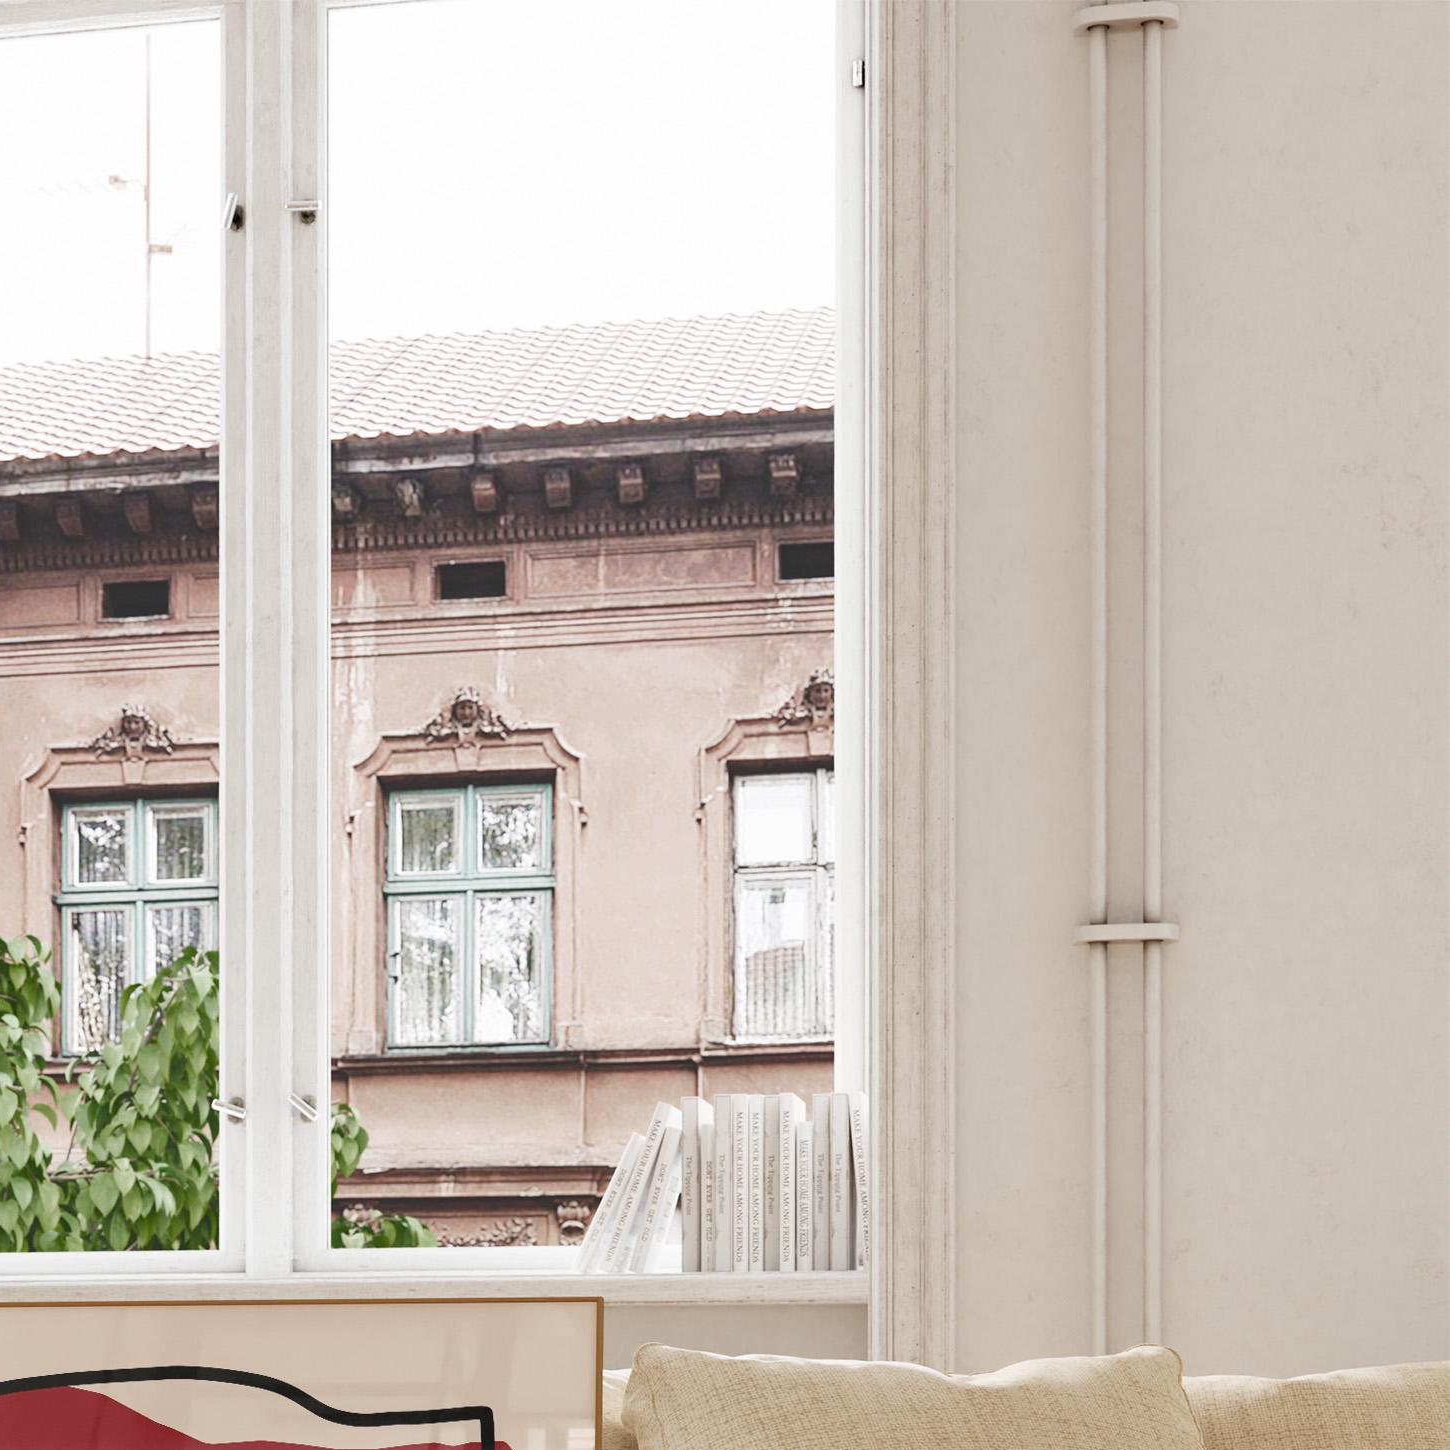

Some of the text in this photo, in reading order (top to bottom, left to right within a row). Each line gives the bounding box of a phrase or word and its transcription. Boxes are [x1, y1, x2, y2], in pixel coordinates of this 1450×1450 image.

[853, 1110, 863, 1133] MAKE
[855, 1135, 865, 1160] YOUR
[817, 1154, 825, 1167] The
[857, 1161, 866, 1188] HOME
[606, 1119, 661, 1262] MAKE YOUR HOME AMONG FRIENDS
